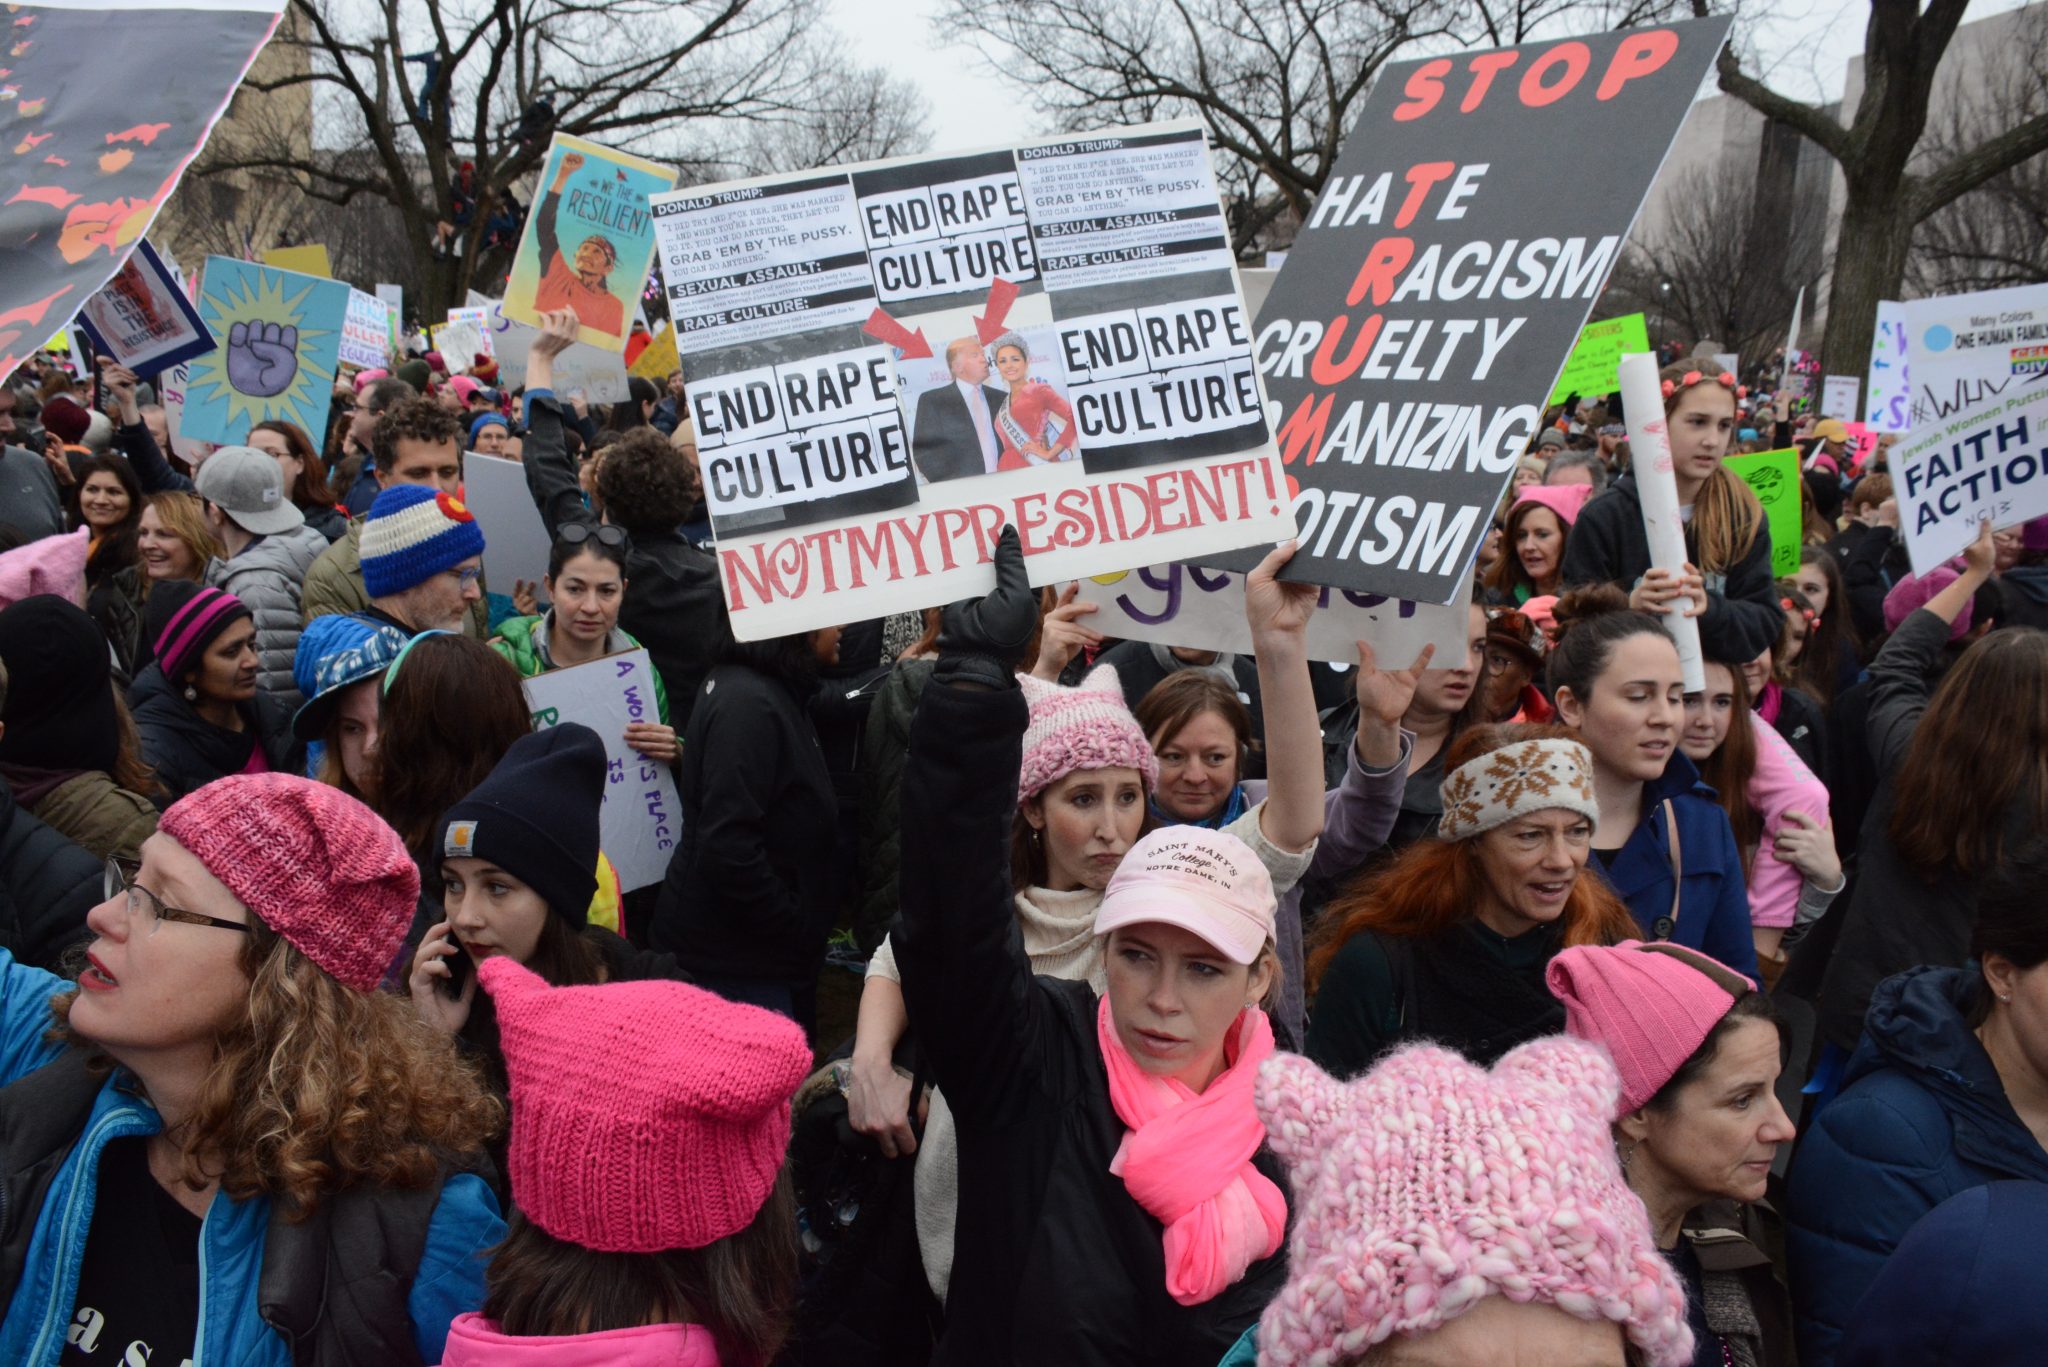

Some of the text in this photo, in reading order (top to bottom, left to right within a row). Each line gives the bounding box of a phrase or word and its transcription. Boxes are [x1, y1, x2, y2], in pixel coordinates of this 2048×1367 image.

[1392, 29, 1679, 121] STOP
[1023, 138, 1123, 160] DONALD TRUMP:
[566, 188, 651, 238] RESILIENT
[601, 179, 634, 202] WE THE
[658, 188, 764, 216] DONALD TRUMP:
[866, 182, 1025, 239] END RAPE
[1034, 193, 1074, 207] GRAB
[1104, 187, 1124, 199] BY
[1126, 184, 1153, 197] THE
[1156, 178, 1205, 194] PUSSY.
[1309, 161, 1490, 229] HATE
[669, 249, 712, 266] GRAB
[744, 238, 764, 252] BY
[767, 232, 797, 248] THE
[800, 223, 852, 243] PUSSY.
[1041, 219, 1100, 236] SEXUAL
[1104, 210, 1176, 228] ASSAULT:
[675, 274, 740, 296] SEXUAL
[744, 260, 822, 284] ASSAULT:
[879, 235, 1035, 292] CULTURE
[1047, 254, 1088, 269] RAPE
[1091, 245, 1164, 264] CULTURE:
[1346, 235, 1620, 306] RACISM
[683, 312, 726, 330] RAPE
[730, 296, 808, 321] CULTURE:
[1970, 311, 2034, 328] Many Colors
[1061, 306, 1249, 372] END RAPE
[1258, 314, 1528, 385] CRUELTY
[1954, 334, 1975, 350] ONE
[1978, 328, 2014, 347] HUMAN
[693, 357, 896, 436] END RAPE
[1076, 370, 1260, 437] CULTURE
[1268, 392, 1540, 474] MANIZING
[1902, 432, 1942, 464] Jewish
[1945, 407, 2002, 436] Women
[2006, 387, 2048, 411] Putti
[709, 424, 908, 503] CULTURE
[1905, 415, 2030, 499] FAITH
[1276, 474, 1481, 577] OTISM
[608, 757, 624, 784] IS
[616, 660, 636, 678] A
[645, 790, 673, 851] PLACE
[1146, 864, 1231, 890] NOTRE DAME, IN
[1147, 842, 1238, 877] SAINT MARY'S
[1171, 852, 1212, 870] College
